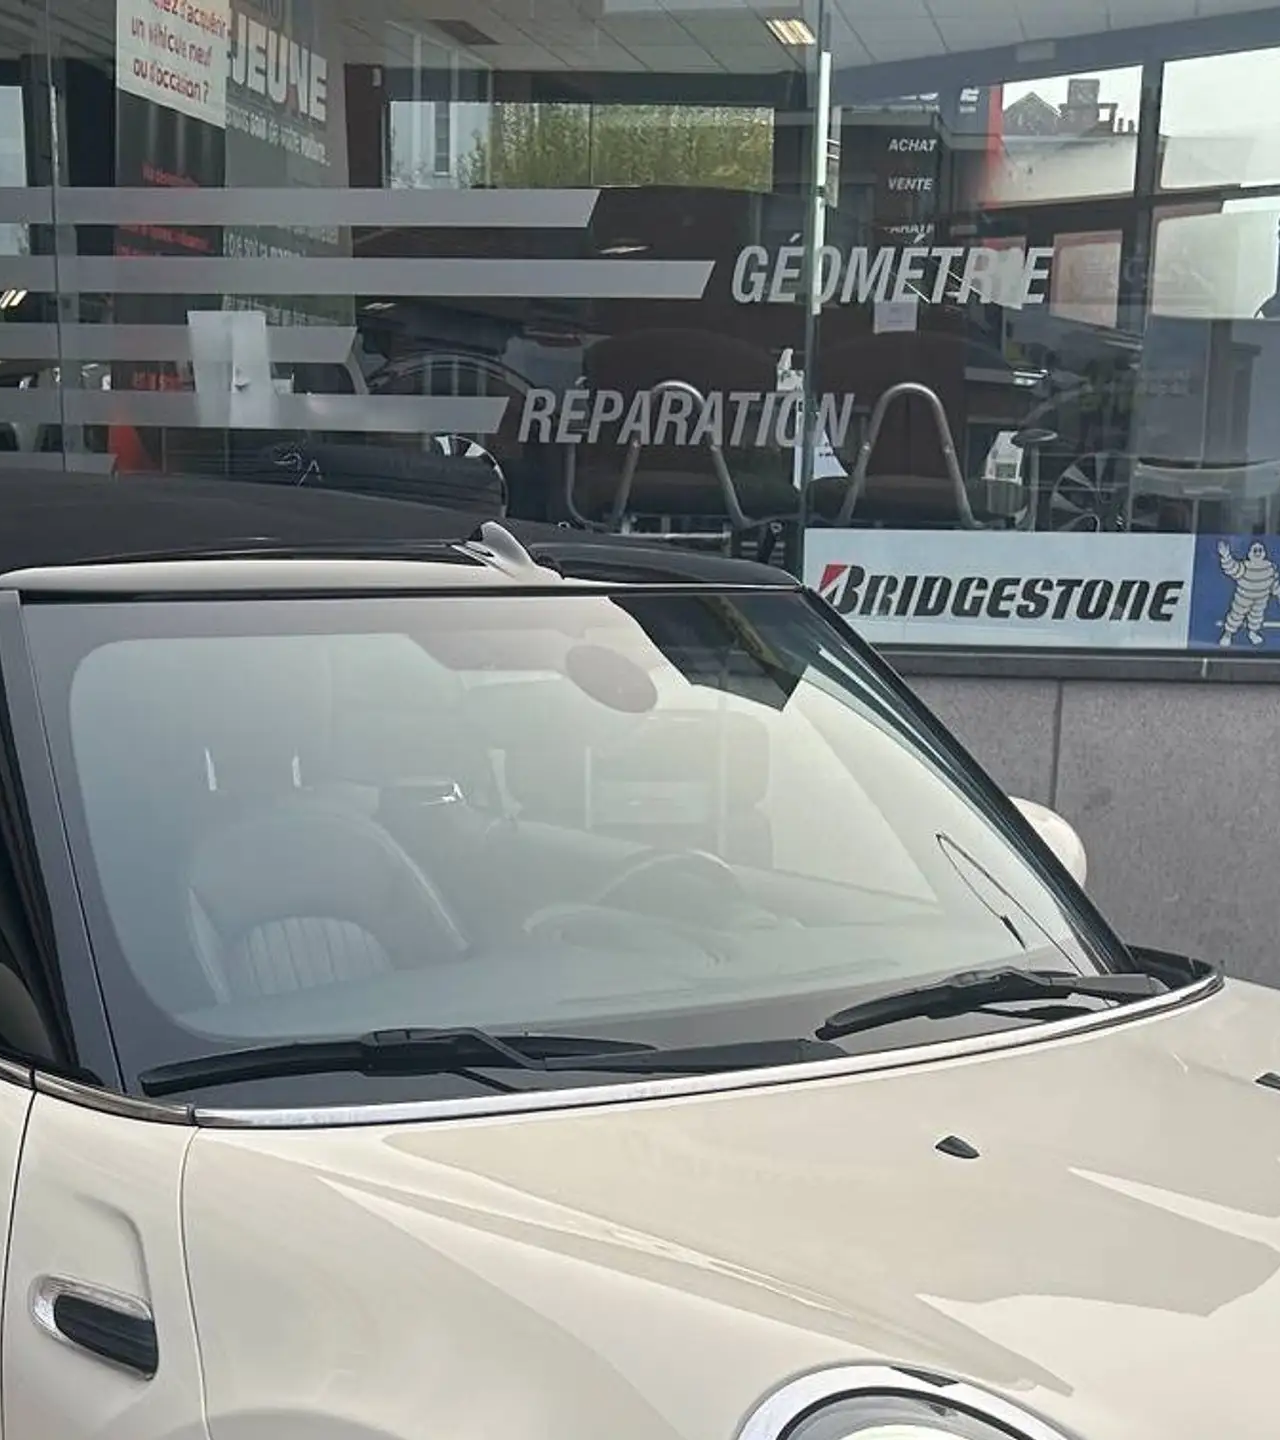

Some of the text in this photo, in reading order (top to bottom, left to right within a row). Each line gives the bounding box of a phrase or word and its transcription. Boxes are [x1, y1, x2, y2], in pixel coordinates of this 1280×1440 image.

[225, 10, 328, 122] JEUNE
[888, 138, 937, 152] ACHAT
[888, 177, 933, 191] VENTE
[731, 232, 1055, 305] GÉOMÉTRIE
[517, 376, 855, 448] RÉPARATION
[818, 563, 1185, 622] BRIDGESTONE
